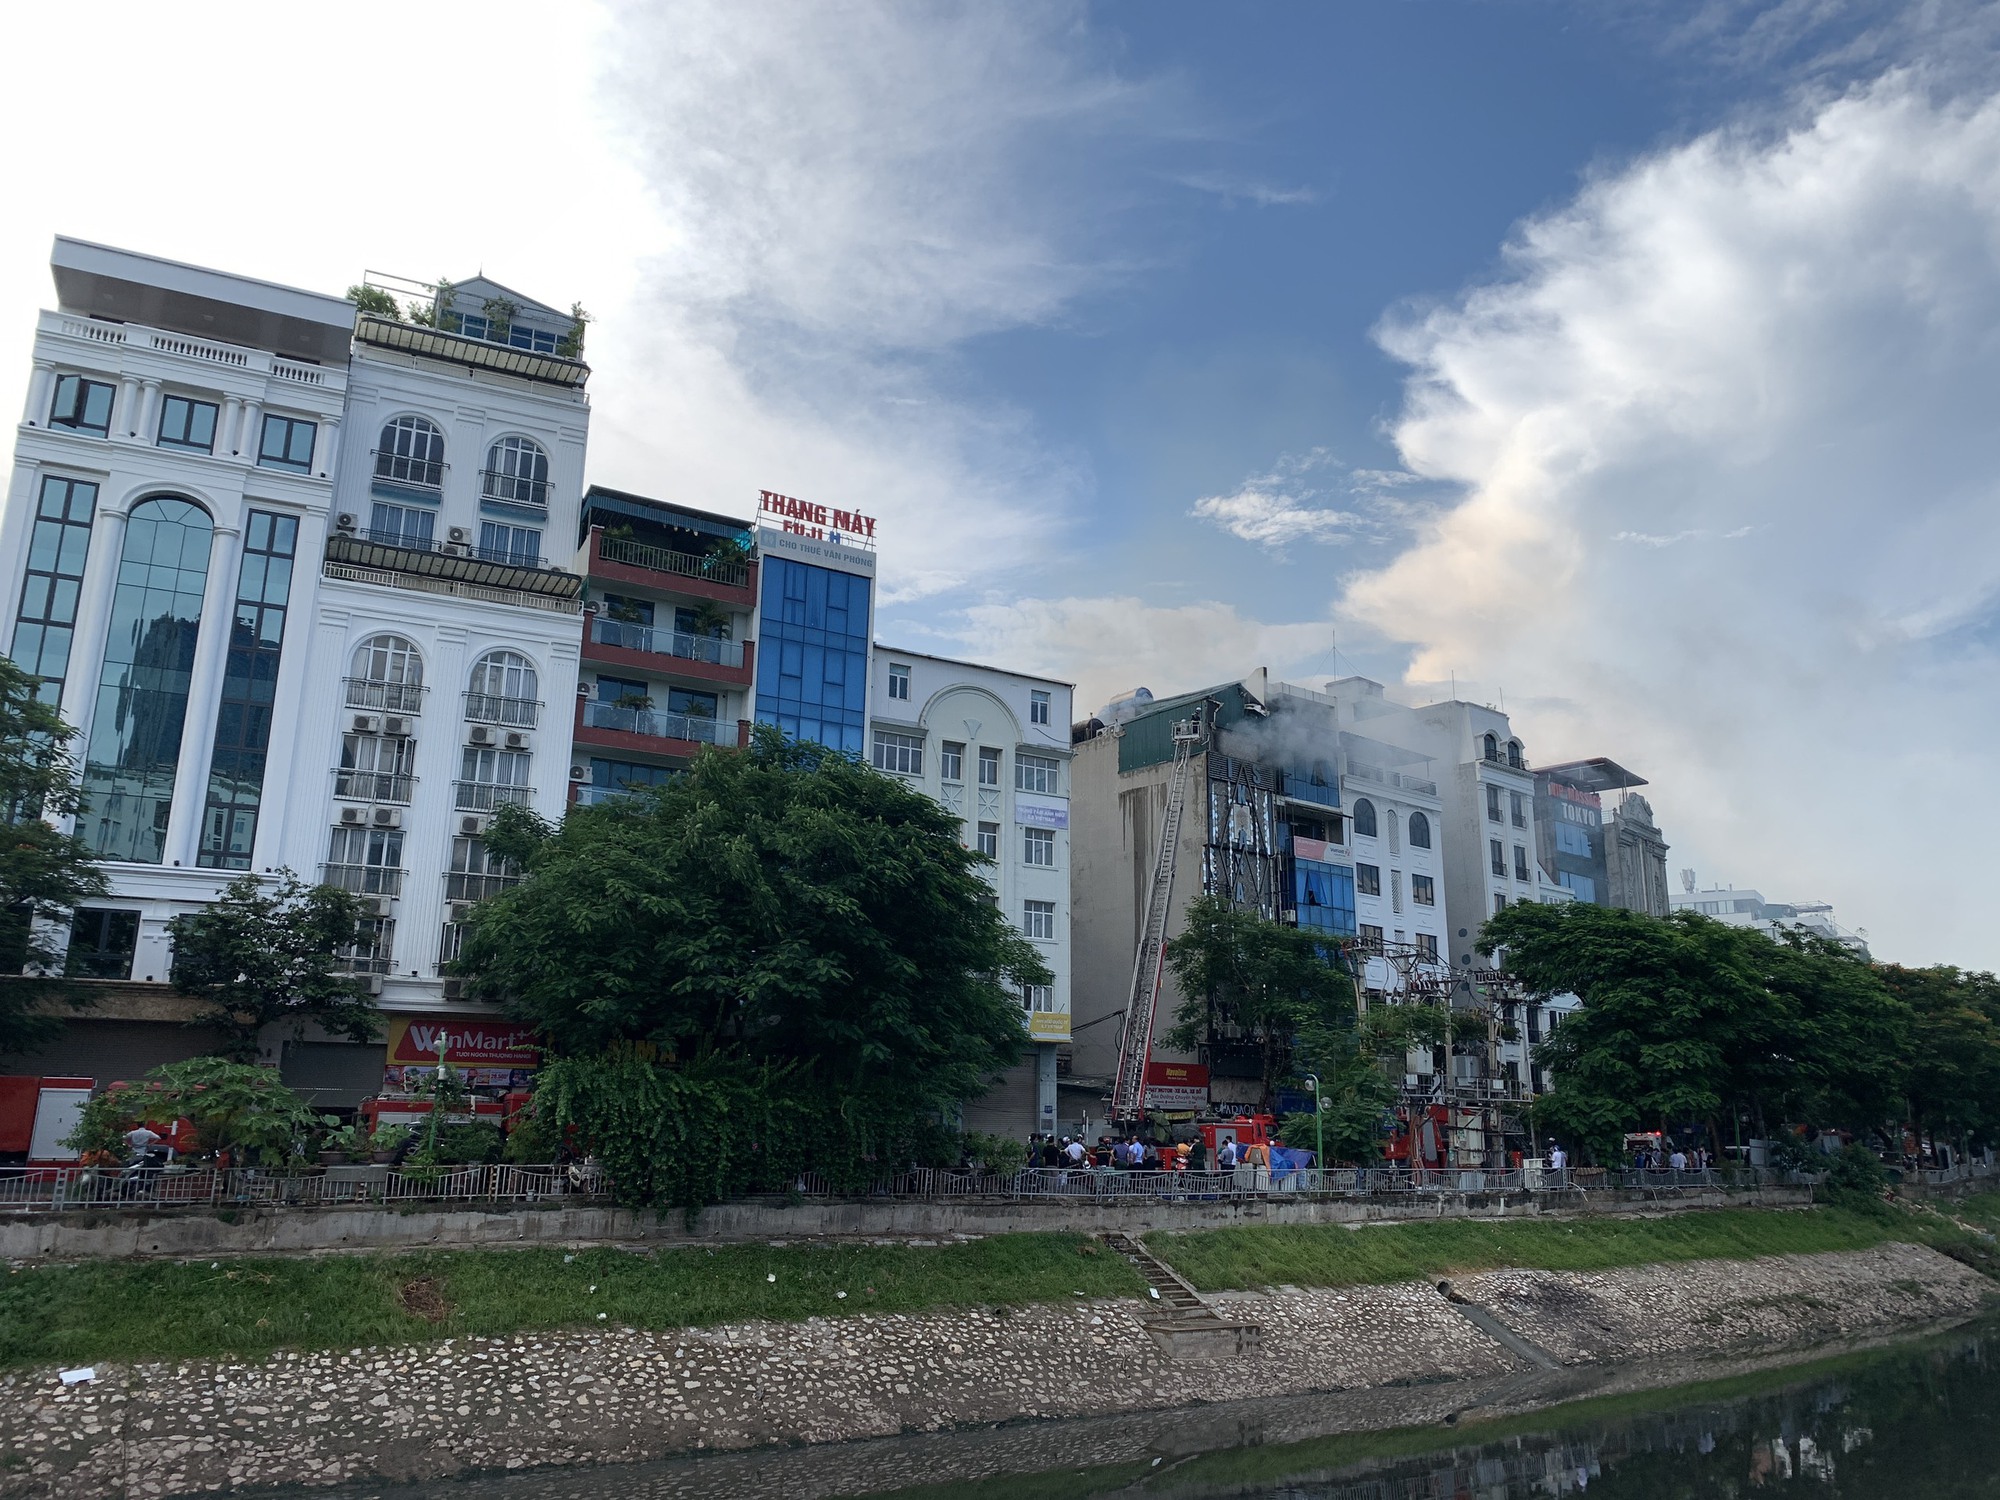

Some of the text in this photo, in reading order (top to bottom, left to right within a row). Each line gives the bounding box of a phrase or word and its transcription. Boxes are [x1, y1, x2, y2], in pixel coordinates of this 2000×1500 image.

[761, 490, 877, 537] THANG MÁY
[779, 539, 797, 549] CHO
[1561, 802, 1596, 827] TOKYO
